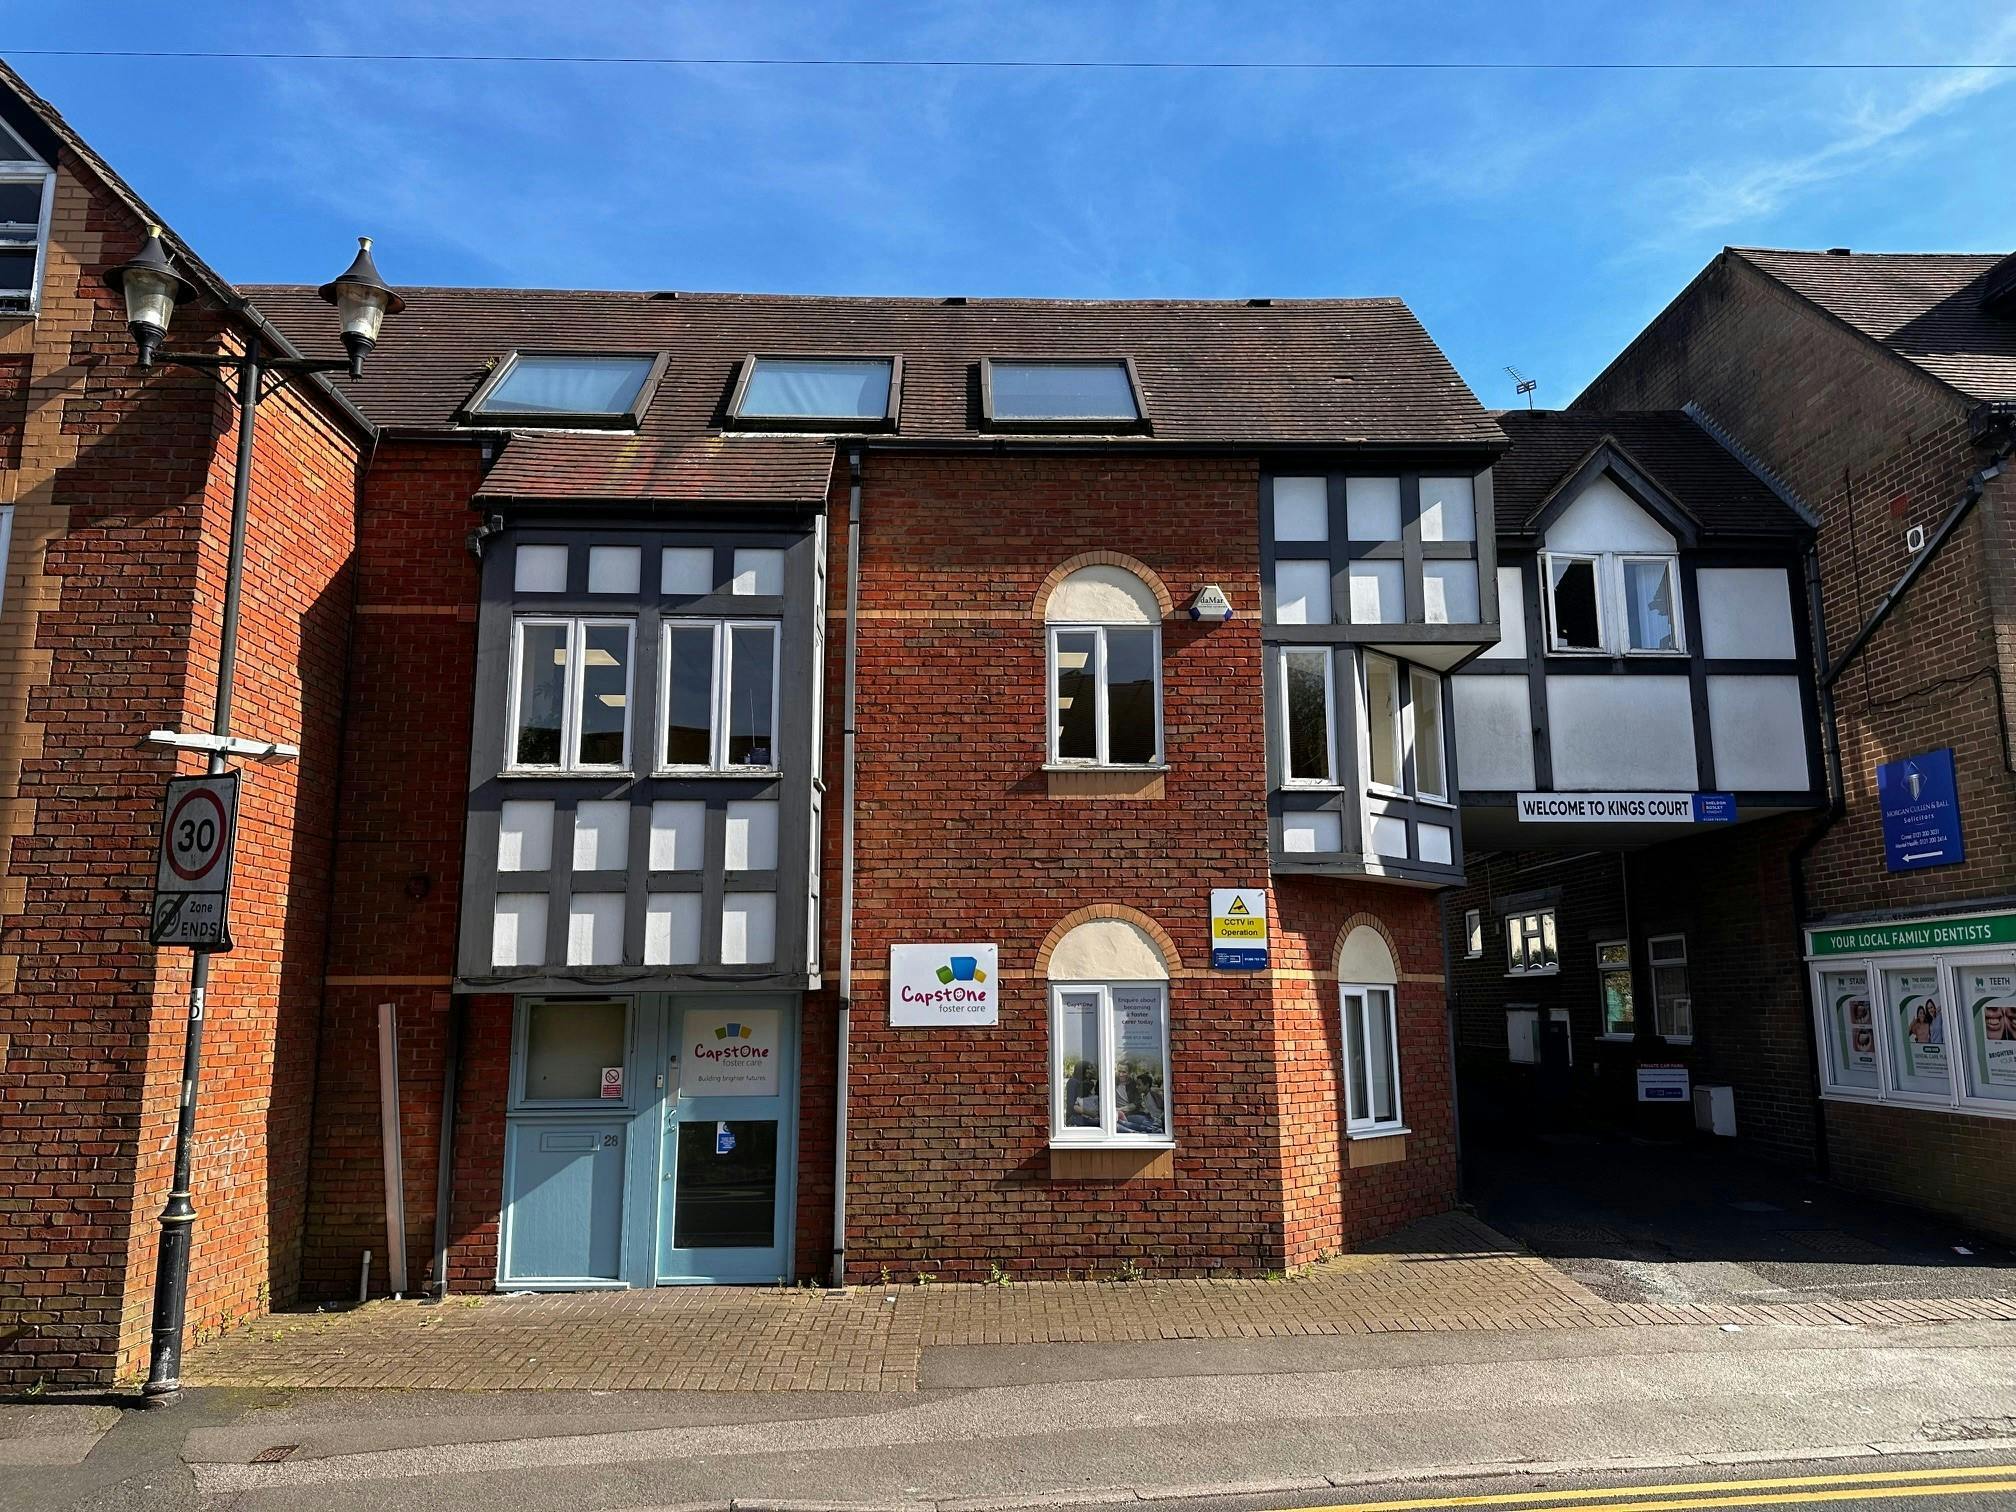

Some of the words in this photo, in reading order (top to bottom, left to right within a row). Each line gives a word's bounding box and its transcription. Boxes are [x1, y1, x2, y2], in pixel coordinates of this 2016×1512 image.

[1523, 801, 1585, 815] WELCOME
[1588, 801, 1605, 815] TO
[1608, 801, 1645, 815] KINGS
[1648, 801, 1689, 815] COURT
[1935, 800, 1950, 808] BALL
[1903, 813, 1935, 823] Solicitors
[178, 818, 215, 853] 30
[190, 901, 213, 914] Zone
[1224, 918, 1246, 926] CCTV
[1247, 918, 1255, 926] in
[181, 921, 218, 938] ENDS
[1830, 935, 1856, 948] YOUR
[1858, 932, 1890, 947] LOCAL
[1892, 930, 1931, 945] FAMILY
[1934, 924, 1992, 942] DENTISTS
[1989, 977, 2011, 985] TEETH
[939, 1004, 964, 1013] foster
[966, 1005, 986, 1013] care
[722, 1059, 744, 1067] foster
[698, 1074, 721, 1082] Building
[722, 1074, 745, 1083] brighter
[603, 1134, 619, 1147] 28
